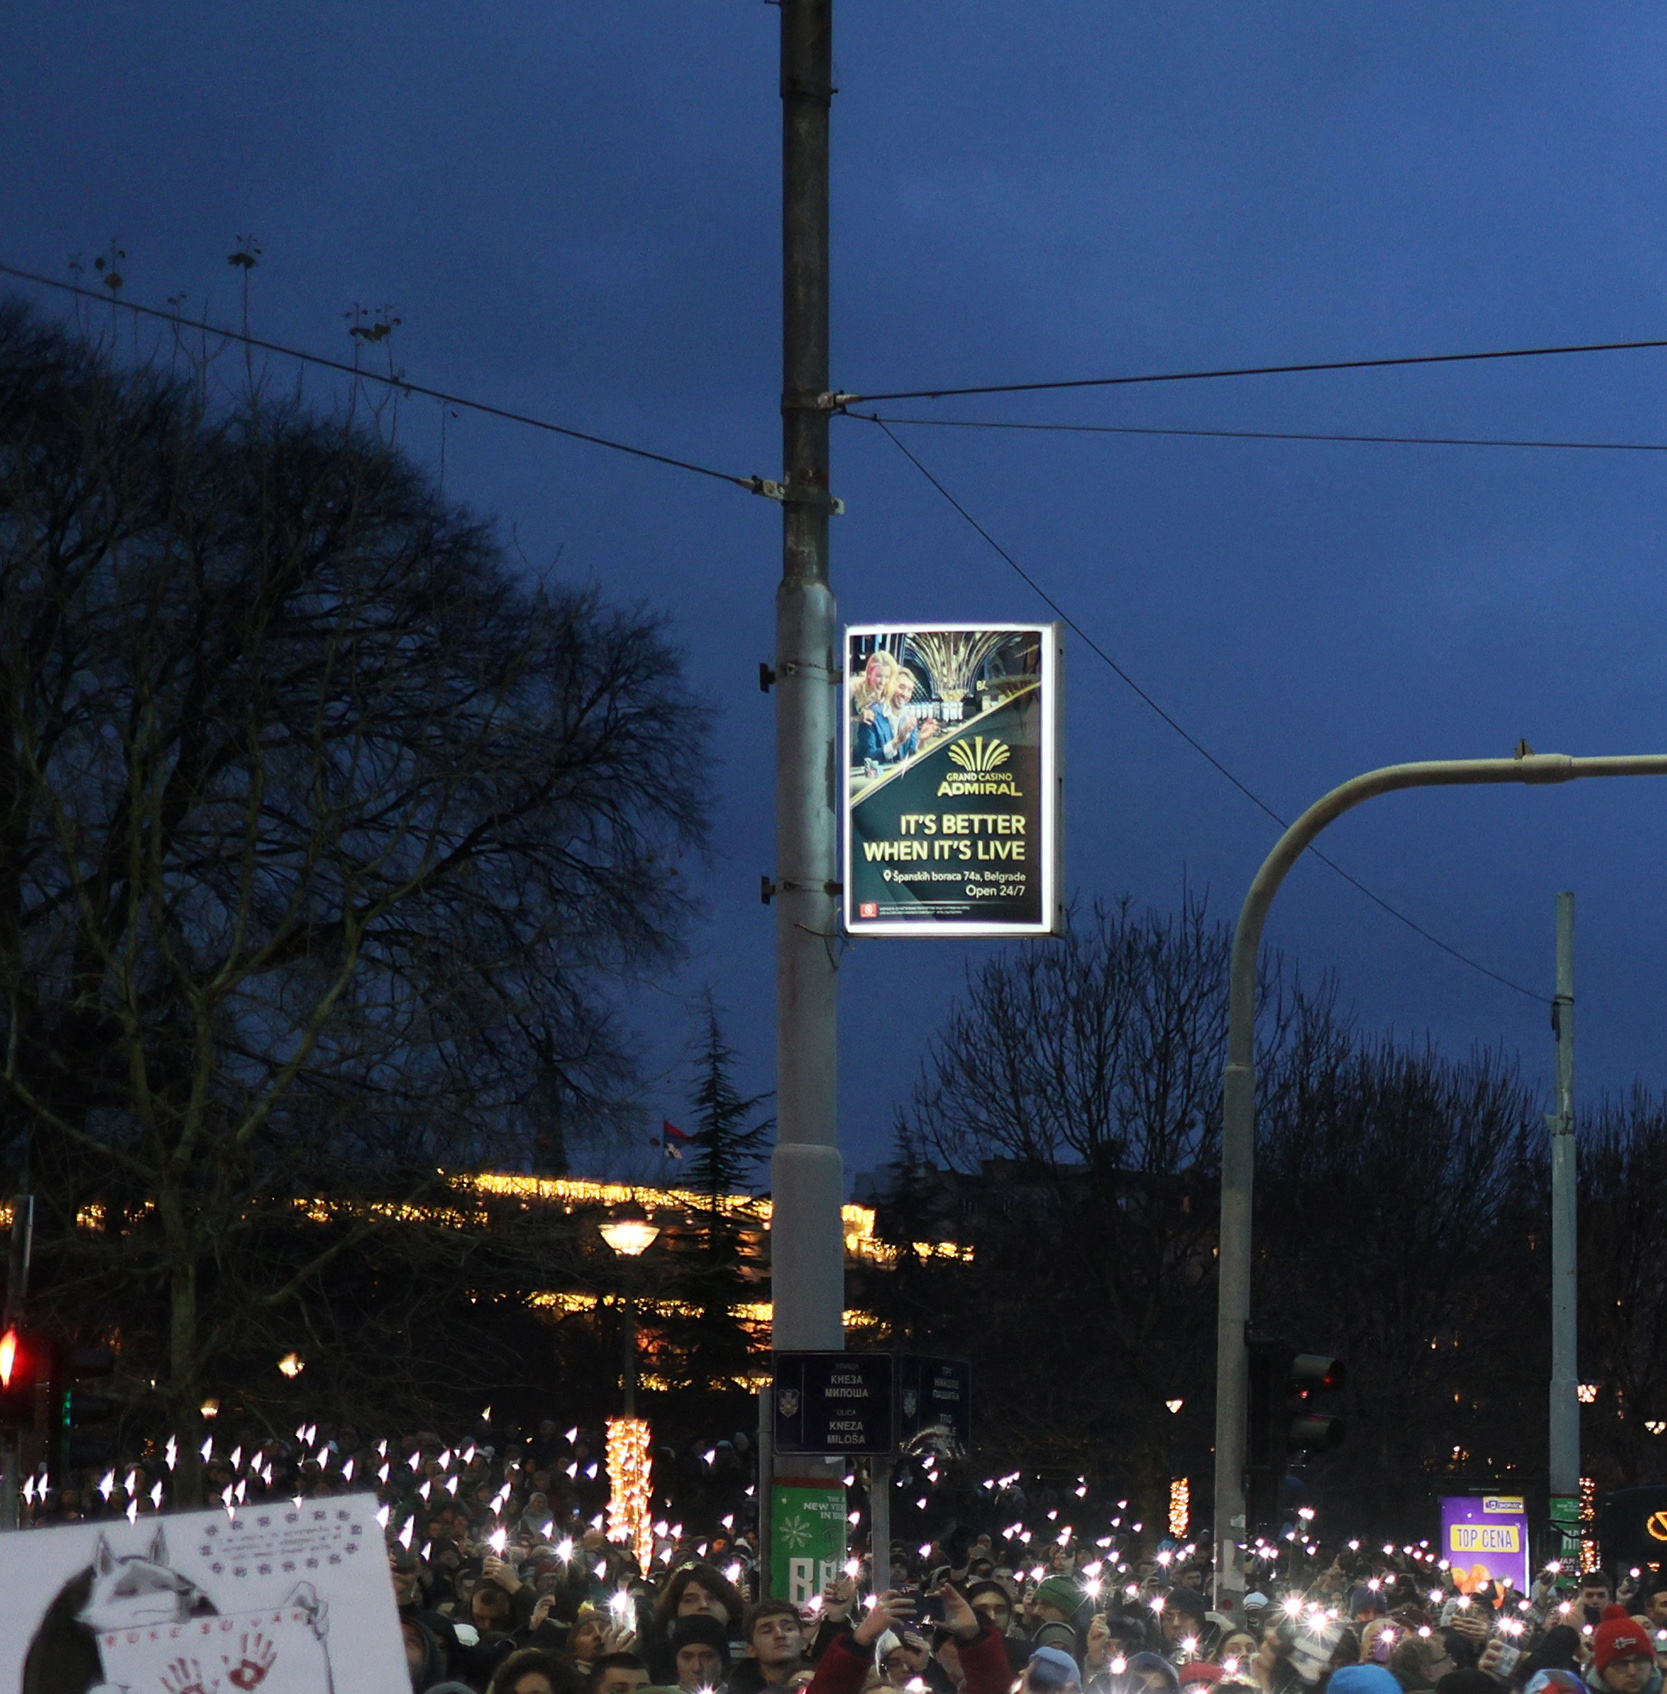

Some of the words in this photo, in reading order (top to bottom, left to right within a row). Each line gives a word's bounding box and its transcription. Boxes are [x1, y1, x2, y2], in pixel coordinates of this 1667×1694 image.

[946, 772, 977, 782] GRAND
[979, 772, 1013, 782] CASINO
[937, 781, 1023, 797] ADMIRAL
[900, 813, 937, 835] IT'S
[942, 813, 1026, 835] BETTER
[863, 840, 928, 862] WHEN
[934, 839, 972, 861] IT'S
[977, 840, 1026, 861] LIVE
[893, 869, 930, 883] Španskih
[932, 871, 962, 881] boraca
[984, 870, 1026, 883] Belgrade
[965, 884, 997, 899] Open
[999, 884, 1025, 896] 24/7
[831, 1375, 863, 1384] КНЕЗА
[825, 1388, 869, 1398] МИЛОША
[829, 1421, 864, 1431] KNEZA
[827, 1432, 866, 1444] MILOŠA
[803, 1502, 829, 1510] NEW
[820, 1512, 831, 1520] IN
[1457, 1529, 1478, 1547] TOP
[1482, 1529, 1513, 1548] CENA
